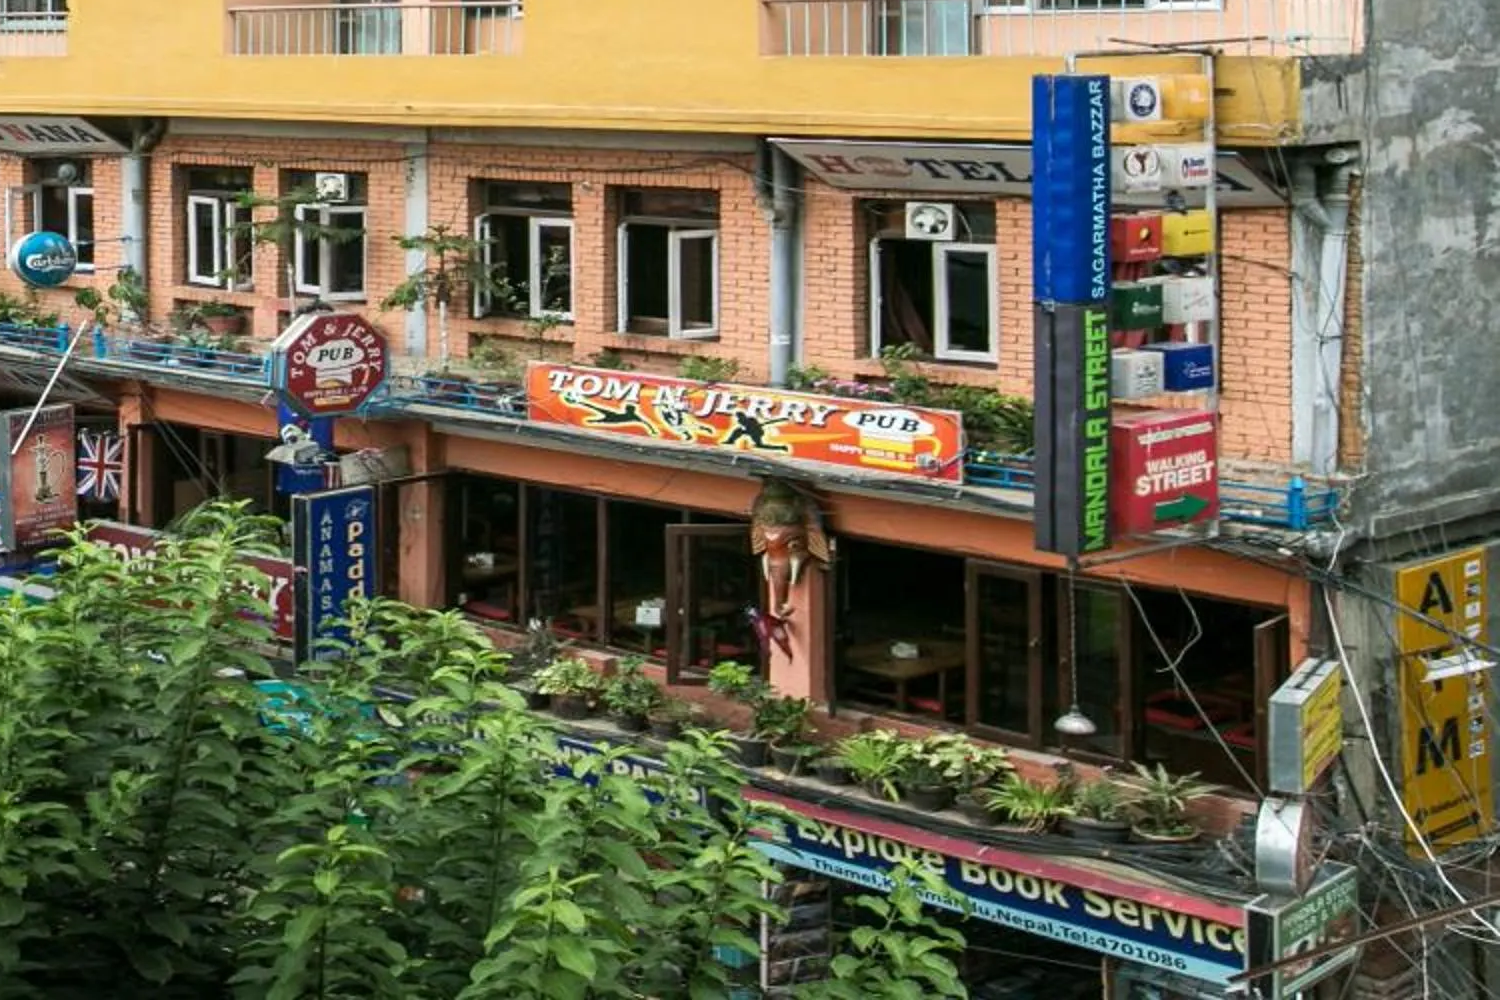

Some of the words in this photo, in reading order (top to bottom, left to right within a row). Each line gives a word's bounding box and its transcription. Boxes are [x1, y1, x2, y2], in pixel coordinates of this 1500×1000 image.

[0, 123, 107, 143] NANA
[1088, 80, 1105, 159] BAZZAR
[804, 153, 1033, 184] HOTEL
[1091, 162, 1105, 299] SAGARMATHA
[291, 333, 318, 380] TOM
[323, 323, 337, 336] &
[342, 322, 382, 371] JERRY
[317, 347, 355, 362] PUB
[1084, 309, 1107, 411] STREET
[547, 370, 641, 402] TOM
[699, 388, 841, 428] JERRY
[857, 412, 920, 433] PUB
[1084, 417, 1108, 550] MANDALA
[1134, 460, 1215, 497] STREET
[1145, 449, 1207, 474] WALKING
